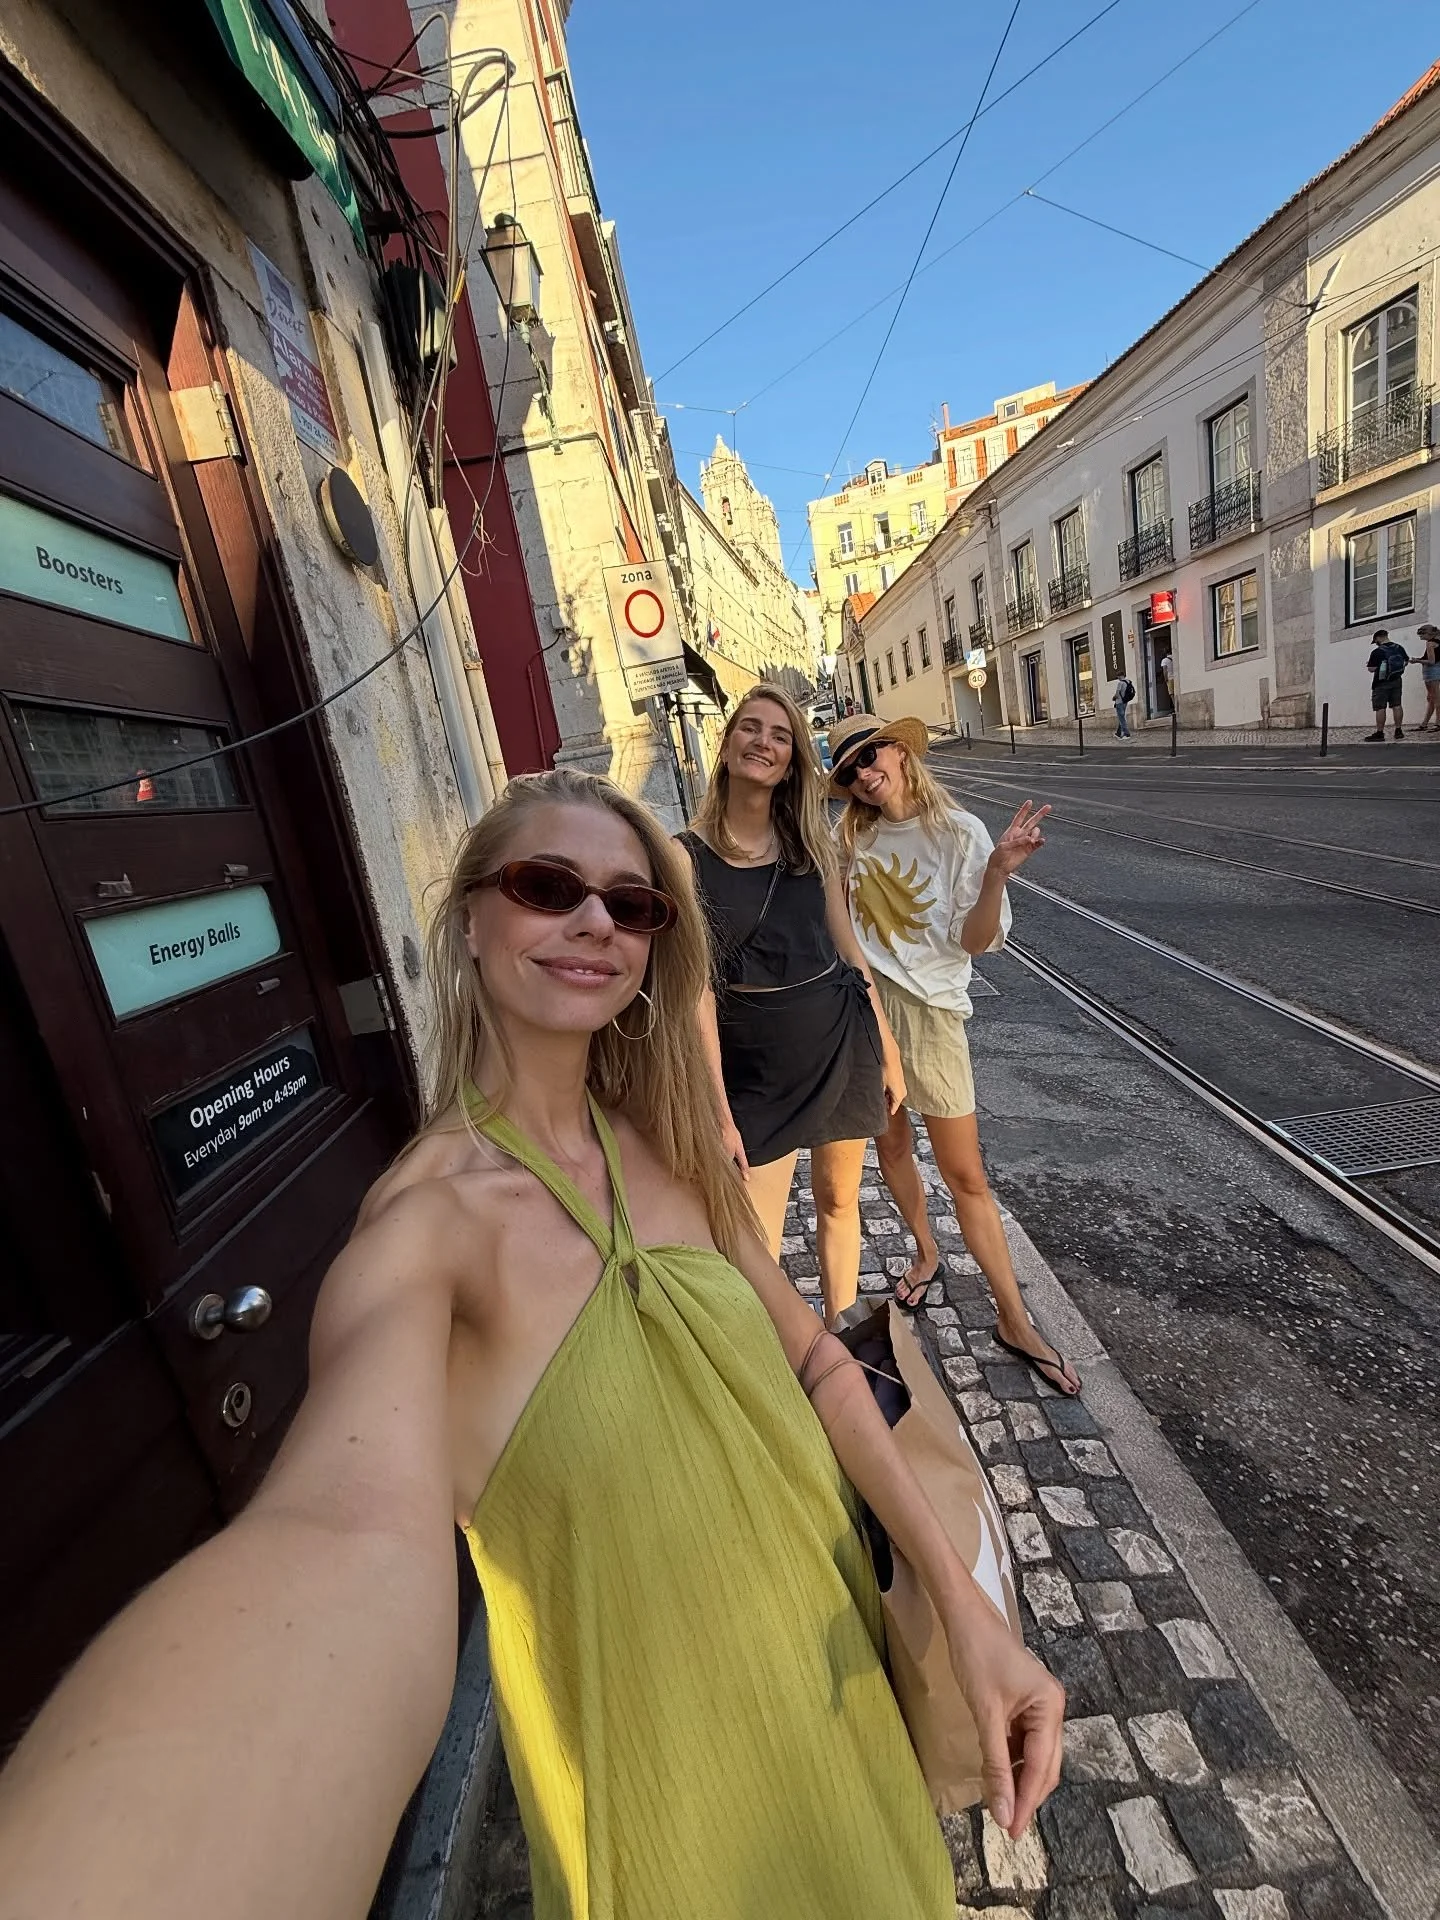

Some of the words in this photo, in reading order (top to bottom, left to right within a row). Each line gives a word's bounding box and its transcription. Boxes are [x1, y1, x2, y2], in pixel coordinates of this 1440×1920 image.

[273, 328, 324, 391] Alarme
[36, 546, 124, 594] Boosters
[621, 570, 652, 583] zona
[149, 935, 205, 965] Energy
[207, 922, 240, 947] Balls
[190, 1080, 255, 1128] Opening
[253, 1056, 290, 1088] Hours
[184, 1123, 237, 1168] Everyday
[238, 1106, 262, 1131] 9am
[262, 1098, 273, 1112] to
[274, 1074, 307, 1104] 4:45pm
